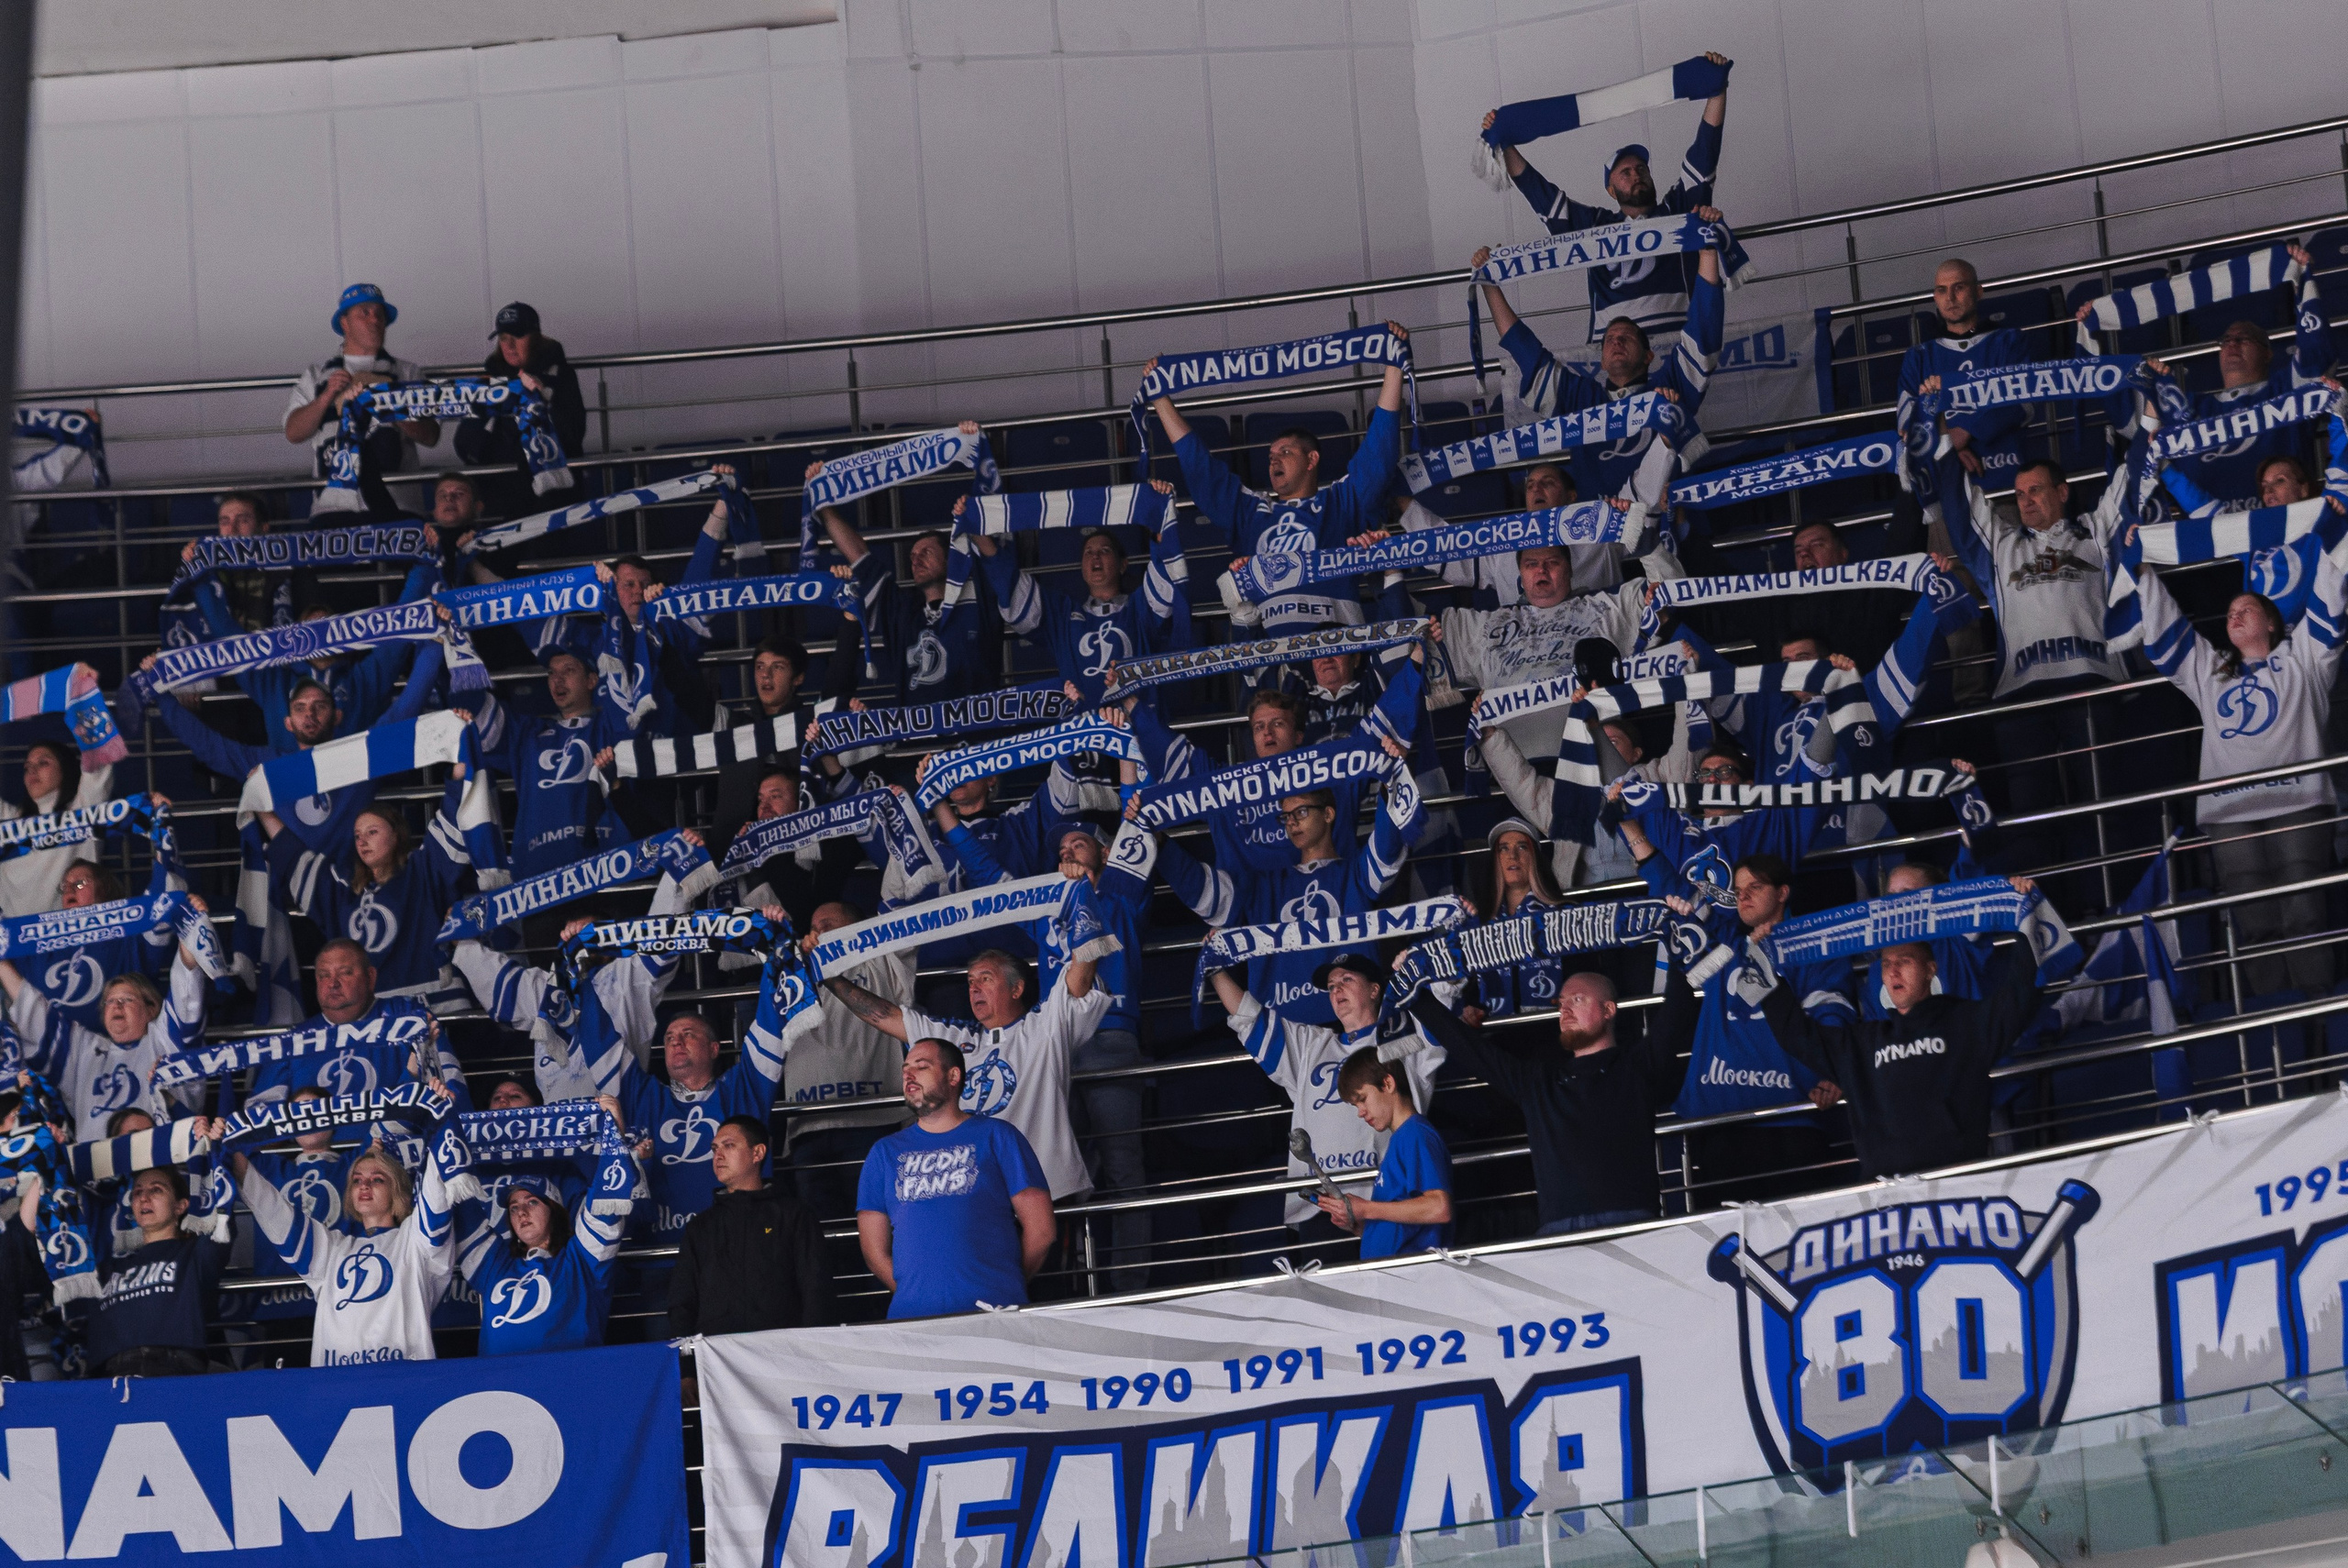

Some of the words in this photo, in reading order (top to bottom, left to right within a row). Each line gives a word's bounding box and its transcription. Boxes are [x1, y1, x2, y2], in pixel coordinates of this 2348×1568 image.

[1590, 223, 1632, 238] КЛУБ
[1144, 350, 1269, 397] DYNAMO
[1948, 363, 2122, 411] ДИНАМО
[371, 384, 509, 413] ДИНАМО
[408, 403, 474, 419] МОСКВА
[908, 432, 946, 453] КЛУБ
[809, 436, 962, 504] ДИНАМО
[1672, 442, 1894, 503] ДИНАМО
[1730, 470, 1833, 500] МОСКВА
[1318, 539, 1428, 570] ДИНАМО
[1435, 517, 1542, 553] МОСКВА
[539, 572, 576, 588] КЛУБ
[1318, 564, 1375, 579] ЧЕМПИОН
[1377, 556, 1424, 570] РОССИИ
[1675, 570, 1791, 602] ДИНАМО
[1799, 559, 1908, 588] МОСКВА
[457, 582, 601, 628] ИНАМО
[652, 580, 823, 623] ДИНАМО
[1260, 602, 1334, 621] IMPBET
[161, 634, 272, 682] ДИНАМО
[325, 602, 435, 644] МОСКВА
[1117, 640, 1279, 686] ДИНАМО
[919, 753, 1013, 810] ДИНАМО
[1019, 734, 1124, 764] МОСКВА
[1211, 760, 1271, 783] HOCKEY
[1278, 749, 1319, 767] CLUB
[1140, 774, 1263, 827] DYNAMO
[1268, 749, 1393, 796] MOSCOW
[0, 798, 130, 847] ДИНАМО
[31, 826, 94, 849] МОСКВА
[758, 811, 825, 846] ДИНАМО!
[829, 801, 855, 823] МЫ
[493, 849, 633, 924] ДИНАМО
[18, 904, 145, 944] ДИНАМО
[594, 914, 753, 947] ДИНАМО
[821, 938, 847, 966] ХК
[971, 880, 1066, 919] МОСКВА
[636, 937, 710, 953] МОСКВА
[1422, 937, 1457, 978] ХК
[1700, 1054, 1792, 1088] Москва
[1874, 1036, 1946, 1069] DYNAMO
[791, 1080, 883, 1103] IMPBET
[274, 1110, 385, 1137] МОСКВА
[903, 1148, 971, 1177] HCDM
[902, 1170, 968, 1200] FANS
[1789, 1199, 2024, 1286] ДИНАМО
[1887, 1253, 1925, 1272] 1946
[792, 1391, 903, 1430] 1947
[934, 1380, 1050, 1422] 1954
[1080, 1367, 1193, 1411] 1990
[1223, 1346, 1325, 1394] 1991
[1356, 1330, 1468, 1376] 1992
[1497, 1311, 1611, 1360] 1993
[1793, 1256, 2035, 1447] 80
